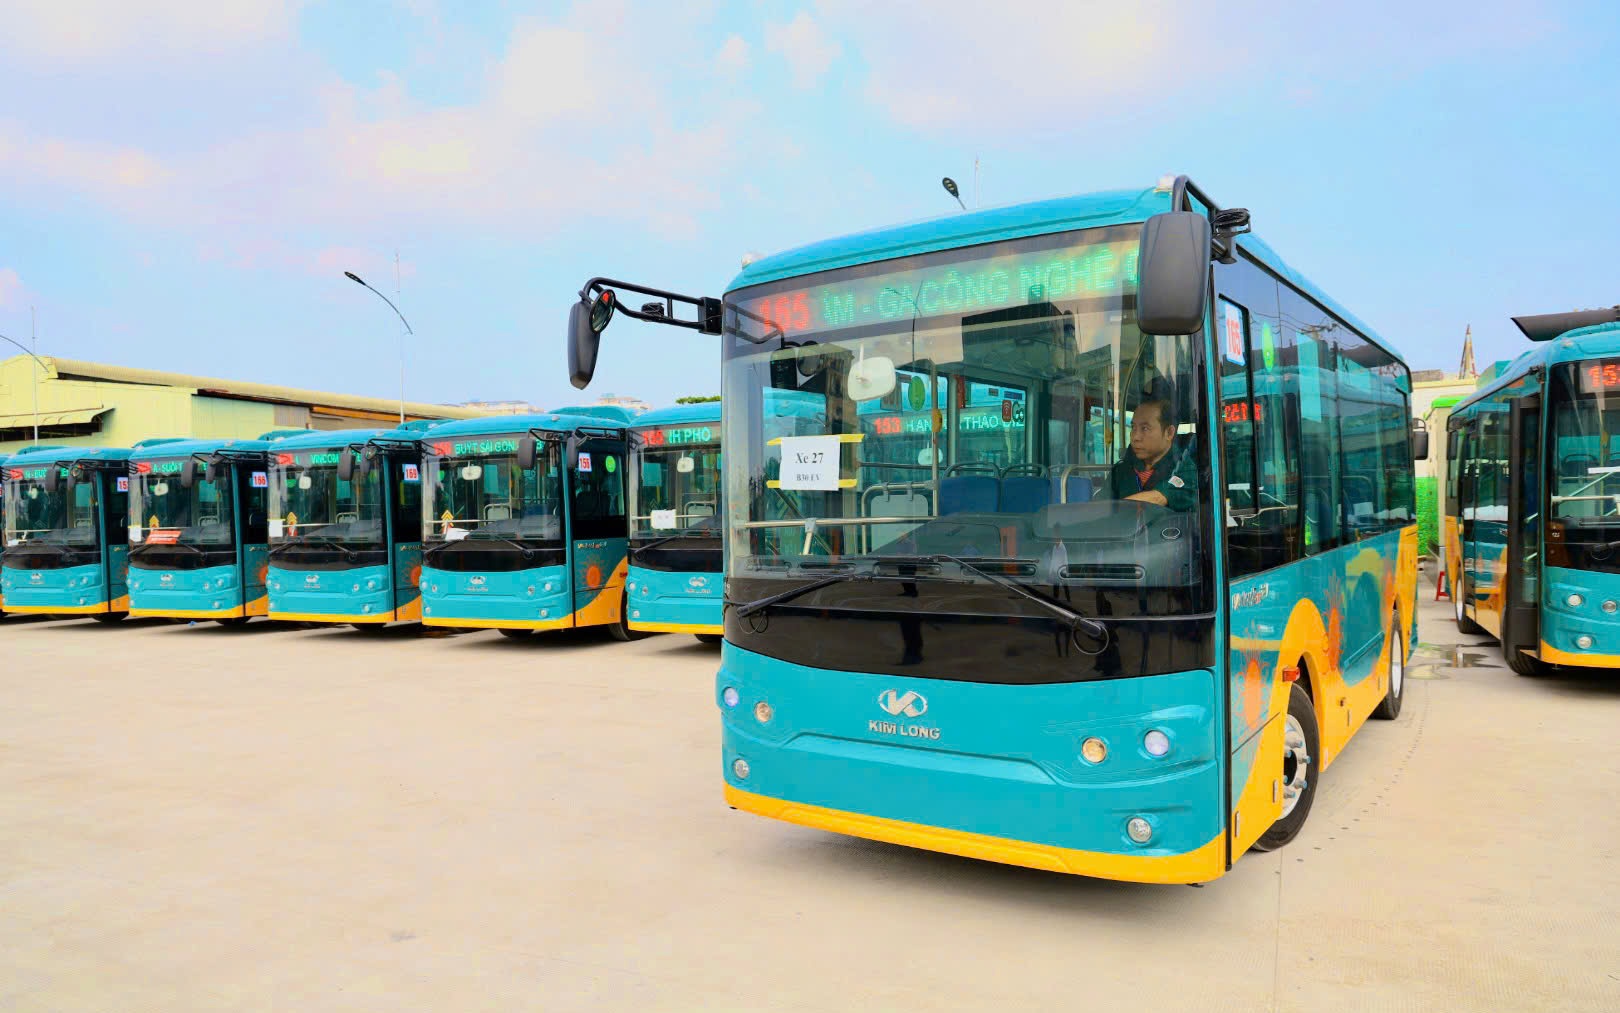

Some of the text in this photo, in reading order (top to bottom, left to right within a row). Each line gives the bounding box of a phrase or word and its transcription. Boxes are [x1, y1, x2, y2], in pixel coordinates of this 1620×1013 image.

[760, 293, 809, 333] 165
[796, 452, 824, 464] Xe 27
[118, 480, 128, 490] 15
[869, 719, 941, 741] KIM LONG
